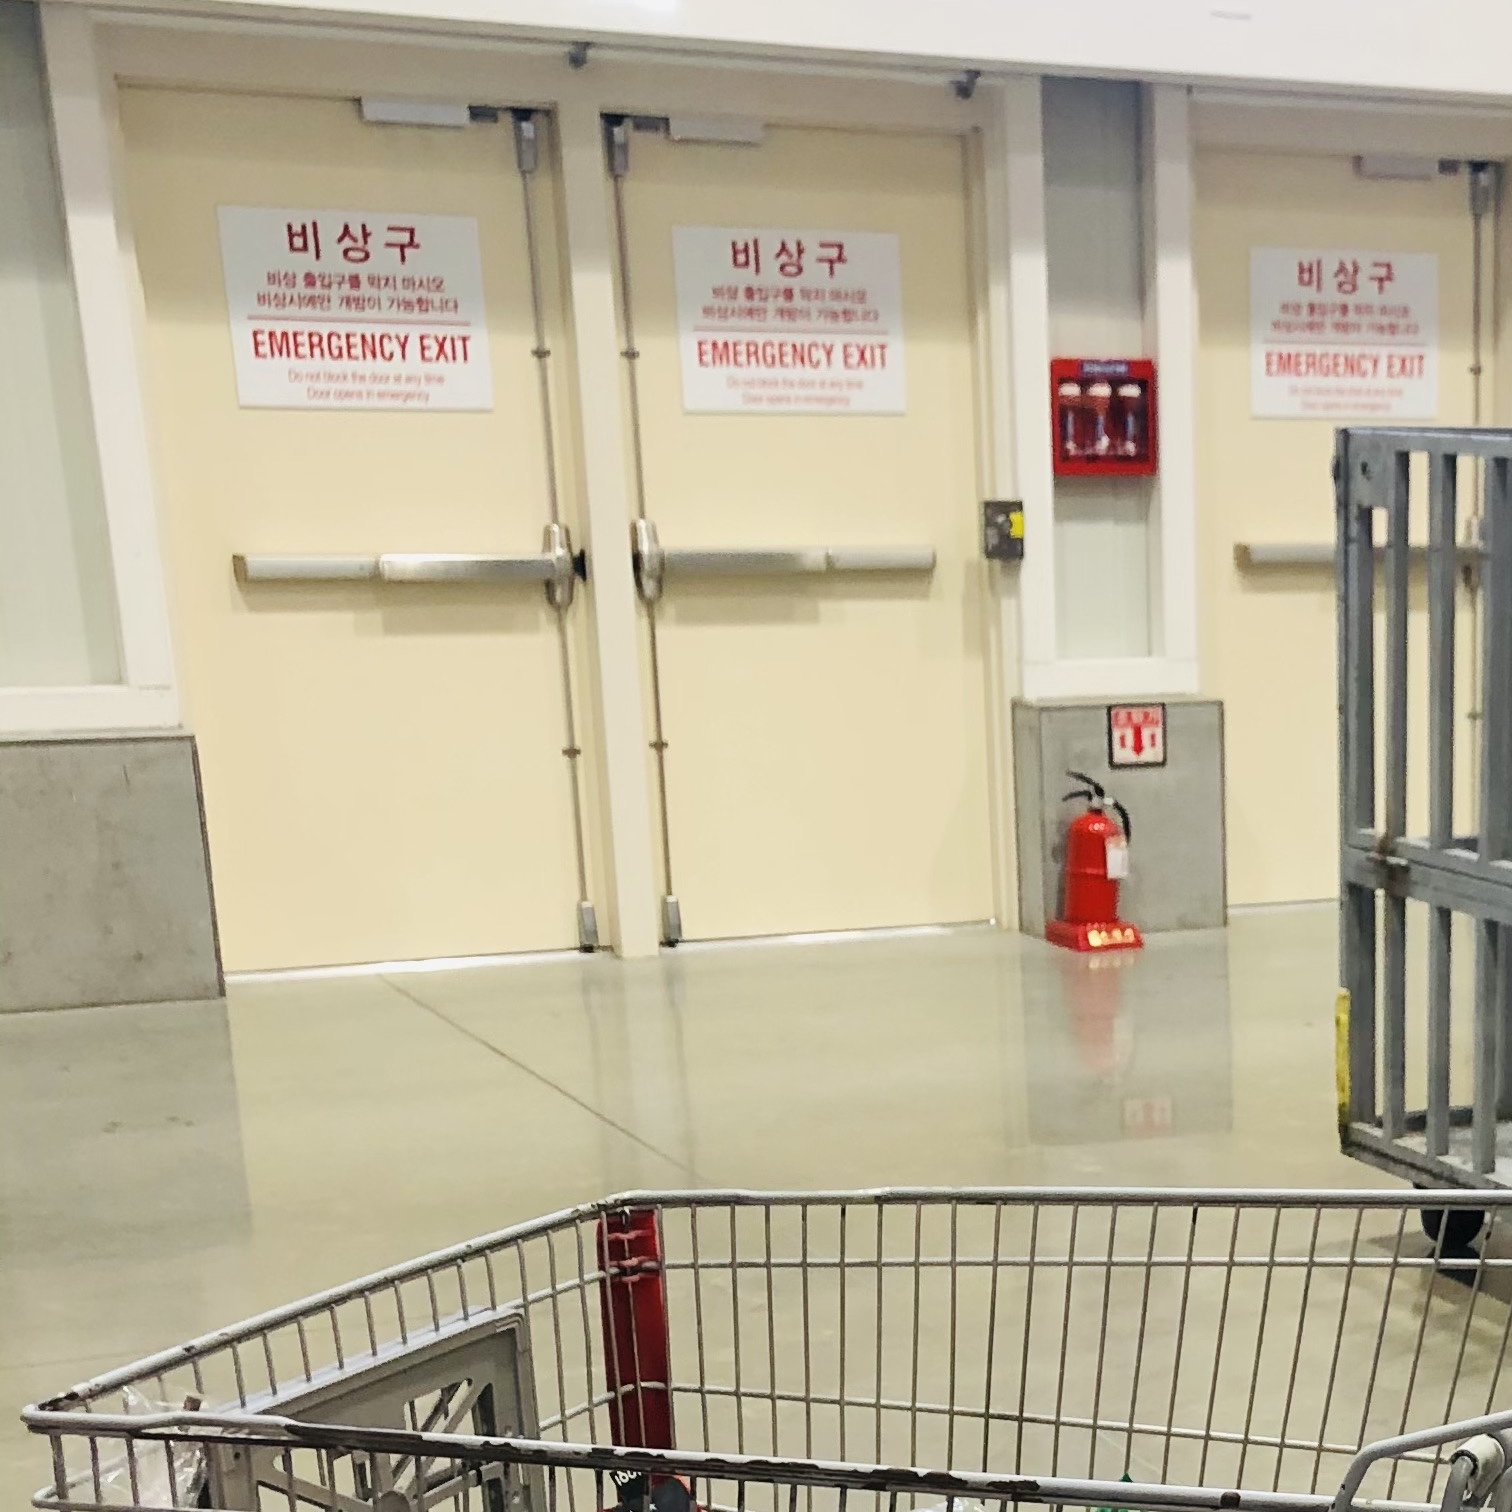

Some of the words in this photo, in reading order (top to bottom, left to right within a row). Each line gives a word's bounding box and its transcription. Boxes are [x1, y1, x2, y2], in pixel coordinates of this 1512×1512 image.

[286, 219, 421, 265] 비상구
[731, 237, 848, 278] 비상구
[1297, 256, 1395, 295] 비상구
[252, 328, 411, 363] EMERGENCY
[420, 333, 471, 364] EXIT
[697, 339, 834, 369] EMERGENCY
[842, 342, 889, 370] EXIT
[1264, 350, 1380, 378] EMERGENCY
[1386, 353, 1426, 379] EXIT
